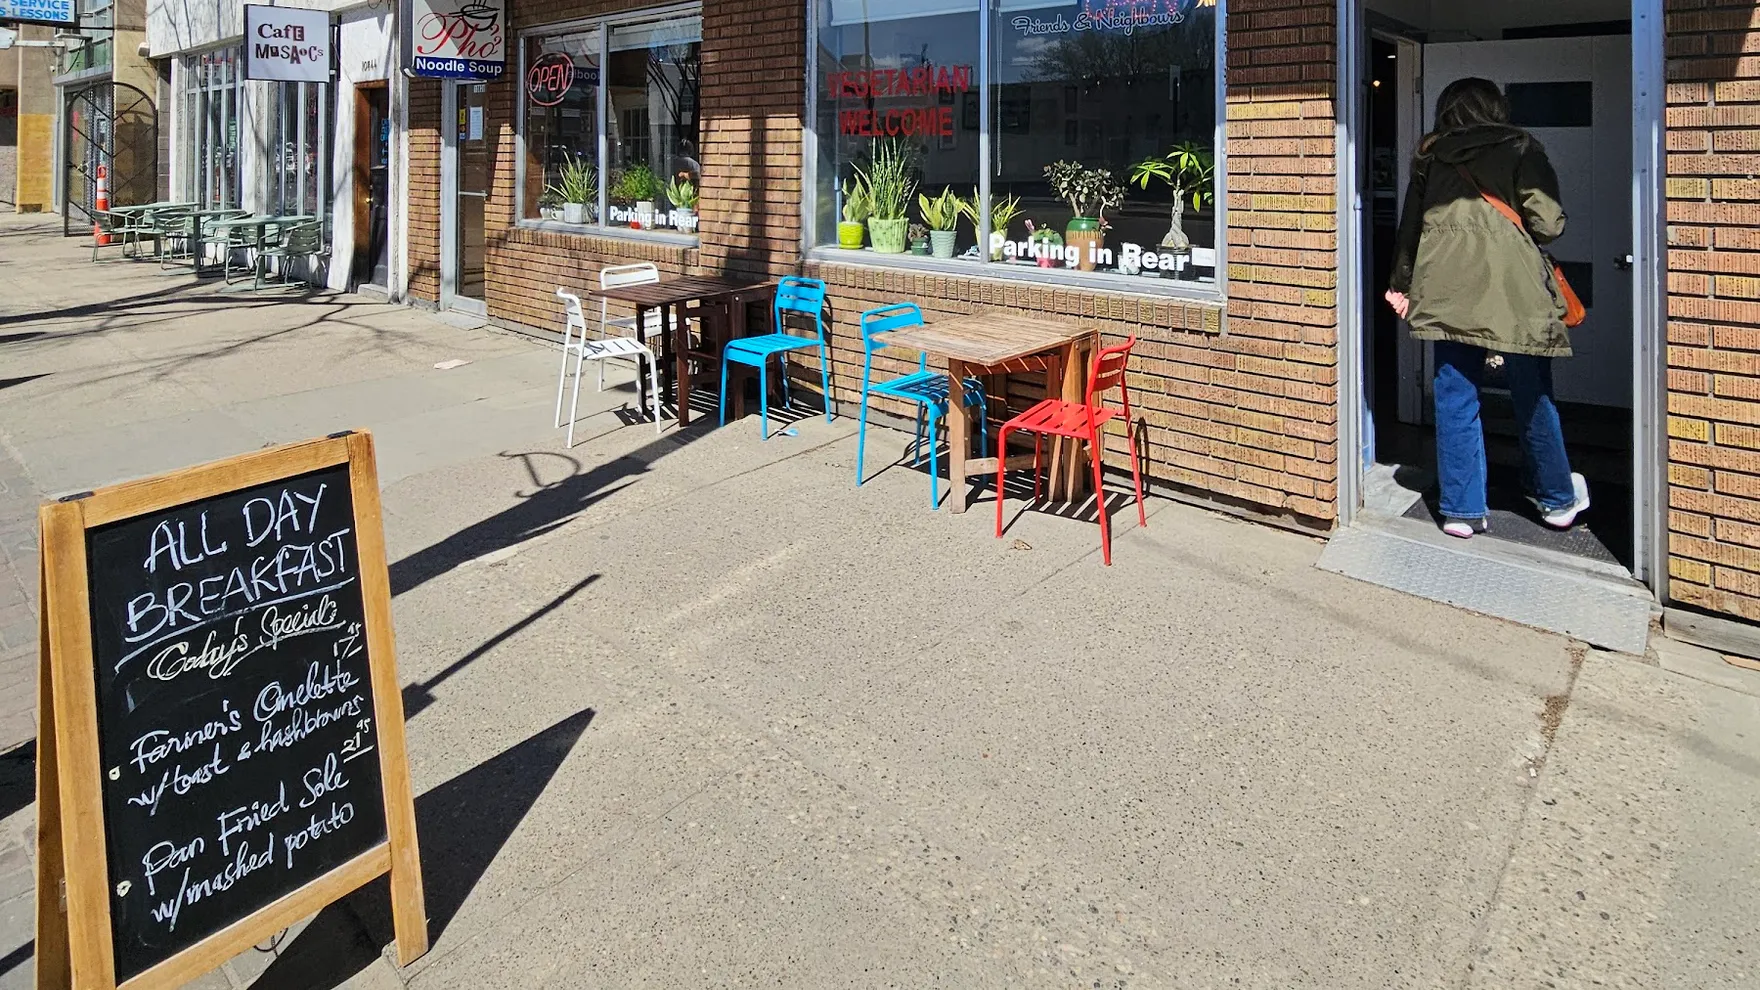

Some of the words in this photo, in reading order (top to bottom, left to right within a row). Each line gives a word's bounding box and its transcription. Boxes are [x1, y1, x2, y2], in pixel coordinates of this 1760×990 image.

[10, 0, 70, 10] SERVICE
[12, 7, 69, 21] LESSONS
[1011, 14, 1070, 36] Friends
[1073, 13, 1092, 31] &
[1095, 7, 1185, 36] Neighbours
[416, 57, 465, 72] Noodle
[468, 61, 502, 76] Soup
[529, 63, 571, 92] OPEN
[827, 64, 969, 98] VEGETARIAN
[838, 106, 953, 137] WELCOME
[609, 205, 652, 227] Parking
[654, 208, 667, 226] in
[668, 209, 699, 229] Rear
[988, 232, 1080, 267] Parking
[1088, 241, 1113, 265] in
[1121, 242, 1190, 272] Rear
[143, 509, 228, 574] ALL
[242, 483, 328, 548] DAY
[125, 528, 351, 643] BREAKFAST
[129, 699, 243, 774] Farmer's
[141, 836, 206, 896] Pan
[216, 779, 290, 857] Fried
[299, 752, 350, 809] Sole
[150, 831, 275, 933] w/mashed
[284, 801, 355, 870] potato
